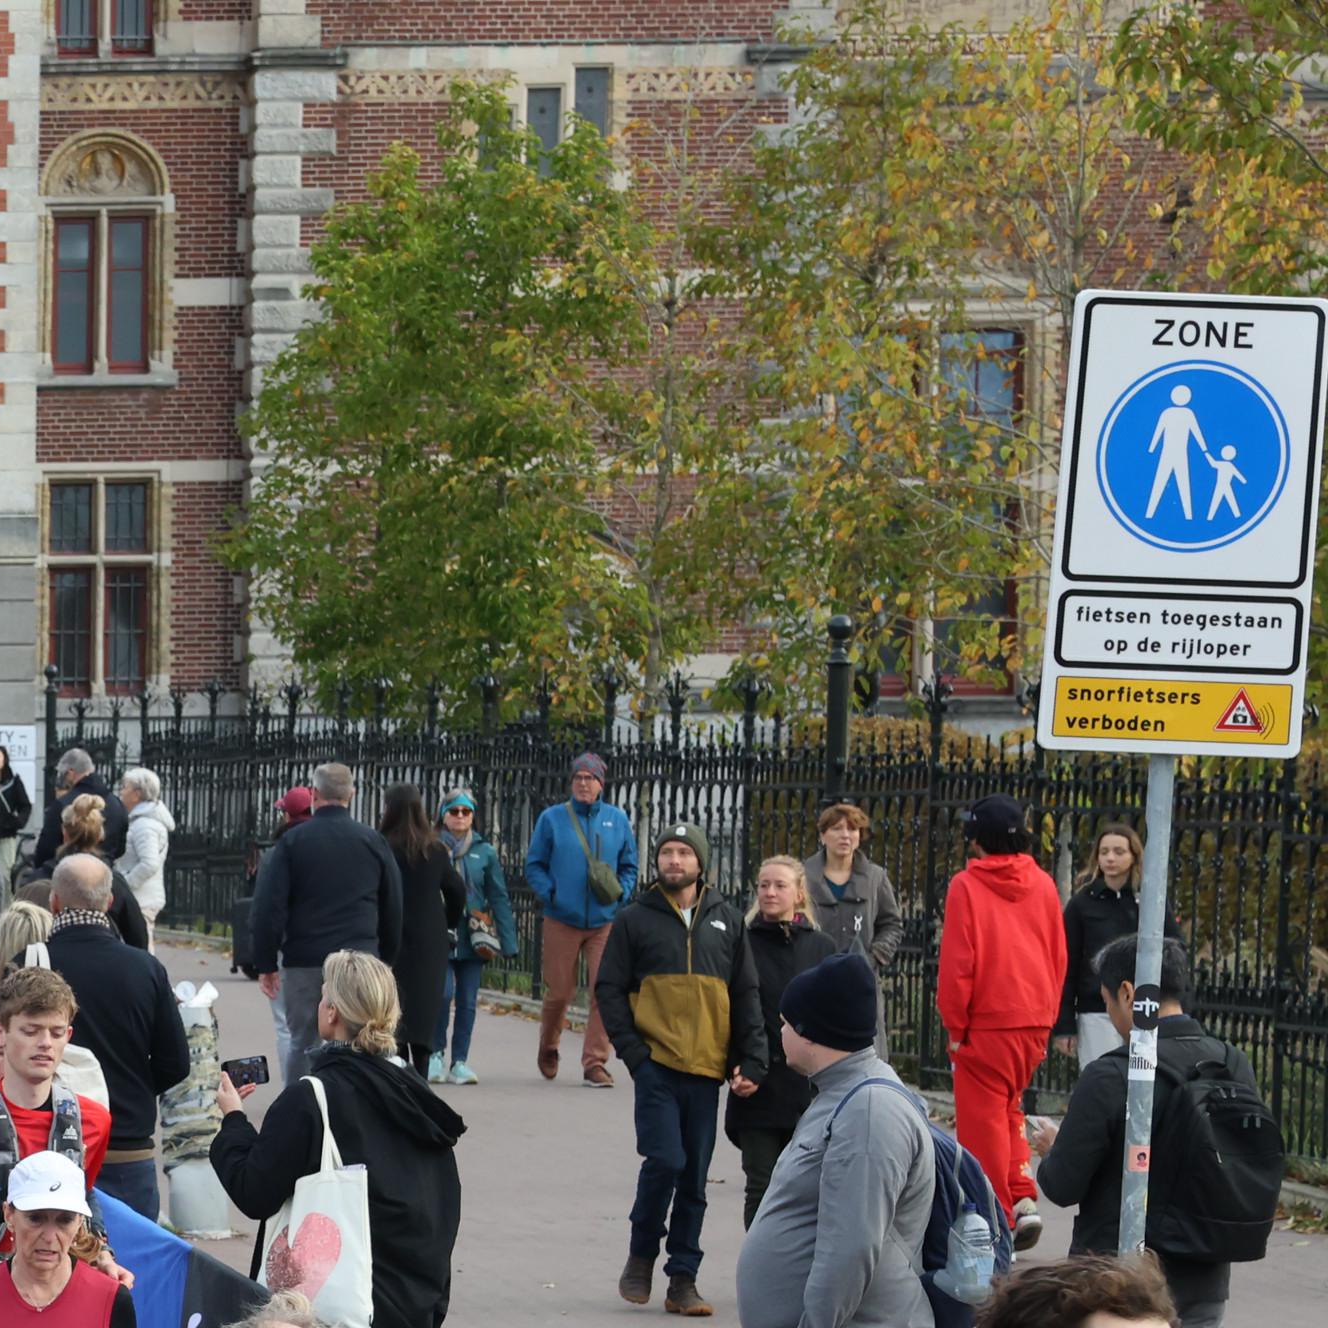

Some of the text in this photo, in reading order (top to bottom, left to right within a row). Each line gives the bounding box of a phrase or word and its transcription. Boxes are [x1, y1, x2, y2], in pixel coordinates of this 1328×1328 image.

[1152, 319, 1255, 349] ZONE
[1076, 606, 1283, 631] fietsen toegestaan
[1104, 638, 1251, 659] op de rijloper
[1067, 686, 1202, 706] snorfietsers
[1065, 714, 1166, 733] verboden
